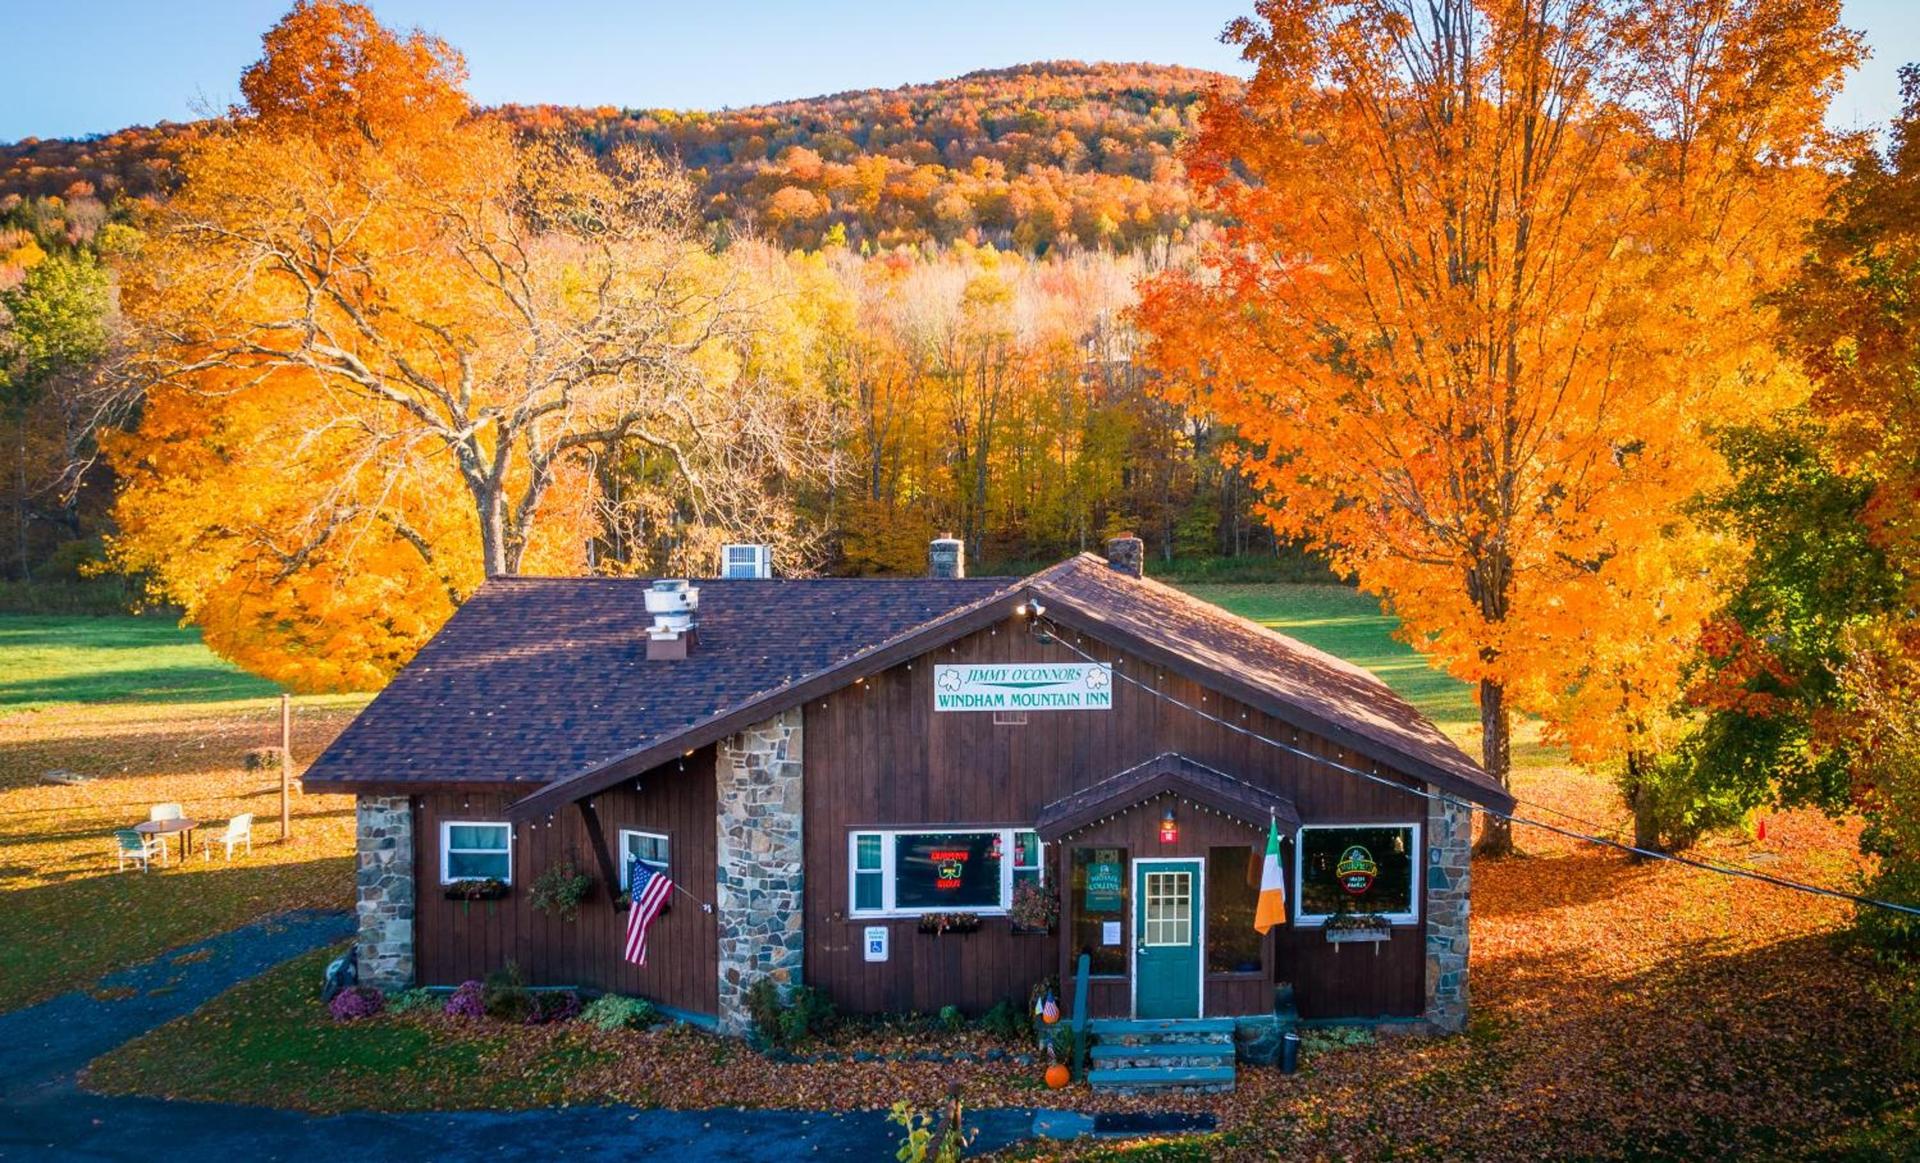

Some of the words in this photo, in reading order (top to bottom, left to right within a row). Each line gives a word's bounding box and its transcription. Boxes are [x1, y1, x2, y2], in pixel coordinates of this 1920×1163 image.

[965, 669, 1008, 684] JIMMY
[1011, 668, 1082, 682] O'CONNORS
[938, 694, 1005, 708] WINDHAM
[1010, 693, 1080, 707] MOUNTAIN
[1086, 692, 1109, 706] INN
